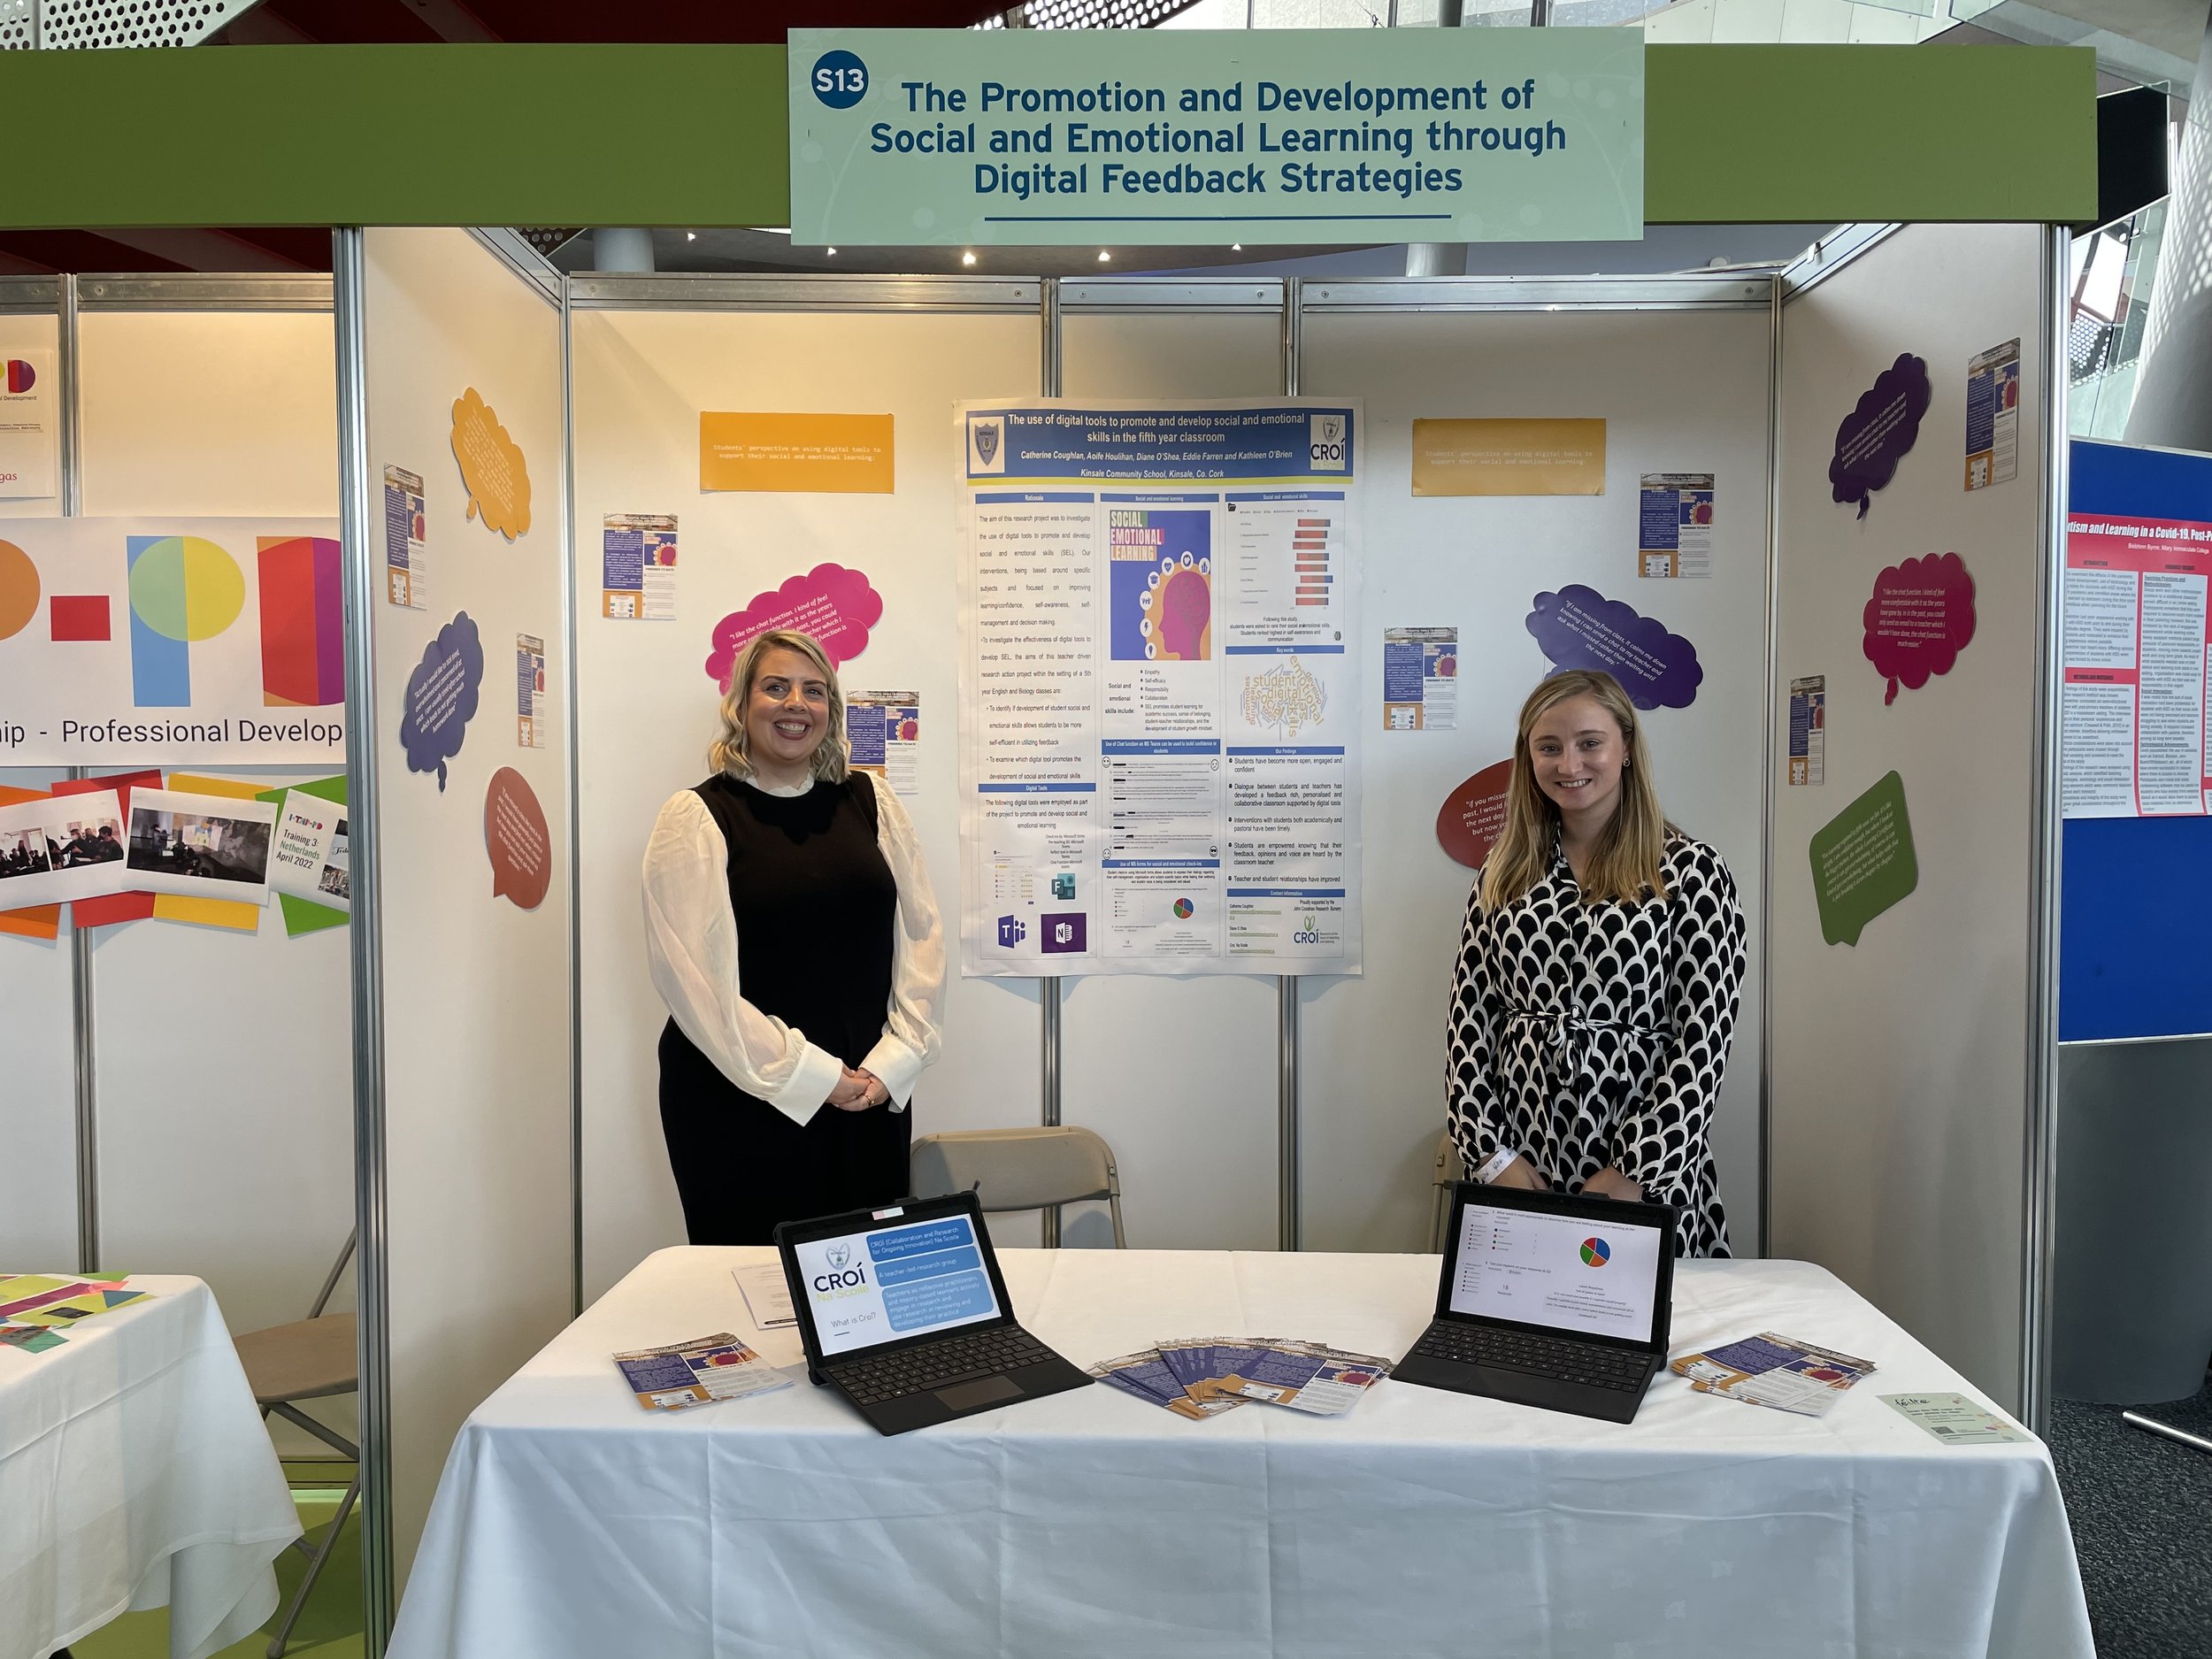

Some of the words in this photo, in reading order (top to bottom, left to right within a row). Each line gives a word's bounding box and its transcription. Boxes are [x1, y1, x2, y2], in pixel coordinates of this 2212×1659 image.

[815, 67, 866, 94] S13
[901, 81, 966, 111] The
[981, 81, 1164, 111] Promotion
[1179, 81, 1241, 111] and
[1257, 79, 1486, 116] Development
[1501, 78, 1534, 109] of
[871, 122, 974, 153] Social
[989, 122, 1051, 153] and
[1067, 121, 1243, 152] Emotional
[1259, 116, 1412, 158] Learning
[1425, 119, 1565, 157] through
[975, 162, 1087, 199] Digital
[1102, 162, 1266, 193] Feedback
[1280, 160, 1462, 198] Strategies
[1008, 413, 1025, 425] The
[1026, 416, 1042, 425] use
[1044, 413, 1054, 425] of
[1056, 414, 1083, 427] digital
[1085, 415, 1107, 426] tools
[1109, 416, 1118, 426] to
[1120, 416, 1156, 428] promote
[1158, 415, 1175, 426] and
[1178, 415, 1211, 428] develop
[1214, 415, 1240, 426] social
[1242, 414, 1258, 425] and
[1261, 412, 1304, 424] emotional
[1087, 431, 1110, 442] skills
[1112, 431, 1120, 442] in
[1122, 431, 1136, 442] the
[1138, 431, 1156, 442] fifth
[1158, 434, 1177, 444] year
[1179, 431, 1225, 442] classroom
[1053, 450, 1085, 461] Coughlan,
[1086, 451, 1103, 460] Aoife
[1104, 452, 1134, 462] Houlihan,
[1156, 452, 1180, 461] O'Shea,
[1224, 451, 1237, 460] and
[1268, 449, 1292, 458] O'Brien
[1310, 437, 1346, 460] CROÍ
[1106, 470, 1142, 479] Community
[1143, 470, 1167, 479] School,
[1169, 470, 1194, 479] Kinsale,
[1110, 511, 1143, 527] SOCIAL
[1110, 528, 1162, 545] EMOTIONAL
[2089, 523, 2104, 534] and
[2105, 523, 2139, 538] Learning
[2140, 525, 2148, 537] in
[2155, 526, 2190, 541] Covid-19,
[2191, 528, 2212, 542] Post-P
[1110, 545, 1155, 561] LEARNING
[756, 619, 769, 629] chat
[769, 610, 794, 626] function.
[797, 602, 810, 611] kind
[817, 594, 827, 604] feel
[1560, 607, 1581, 624] knowing
[1593, 628, 1606, 639] send
[1608, 639, 1620, 649] chat
[1633, 655, 1652, 669] teacher
[1582, 612, 1601, 626] missing
[1600, 623, 1612, 634] from
[1612, 632, 1624, 643] class,
[1630, 643, 1645, 655] calms
[1653, 658, 1666, 669] down
[0, 720, 25, 748] ip
[63, 718, 229, 742] Professional
[239, 718, 343, 748] Develop
[1475, 798, 1486, 807] you
[1478, 816, 1492, 825] next
[1493, 812, 1504, 821] day
[283, 828, 311, 847] Training
[311, 838, 319, 848] 3:
[276, 850, 293, 864] April
[294, 856, 313, 869] 2022
[280, 840, 320, 860] Netherlands
[1294, 928, 1319, 944] CROÍ
[871, 1239, 885, 1248] CROÍ
[885, 1234, 923, 1247] (Collaboration
[933, 1227, 959, 1236] Research
[881, 1245, 904, 1254] Ongoing
[904, 1239, 933, 1249] Innovation)
[813, 1262, 866, 1292] CROÍ
[884, 1263, 917, 1278] teacher-led
[917, 1261, 941, 1271] research
[941, 1258, 957, 1268] group
[816, 1293, 833, 1302] Na
[831, 1317, 849, 1328] What
